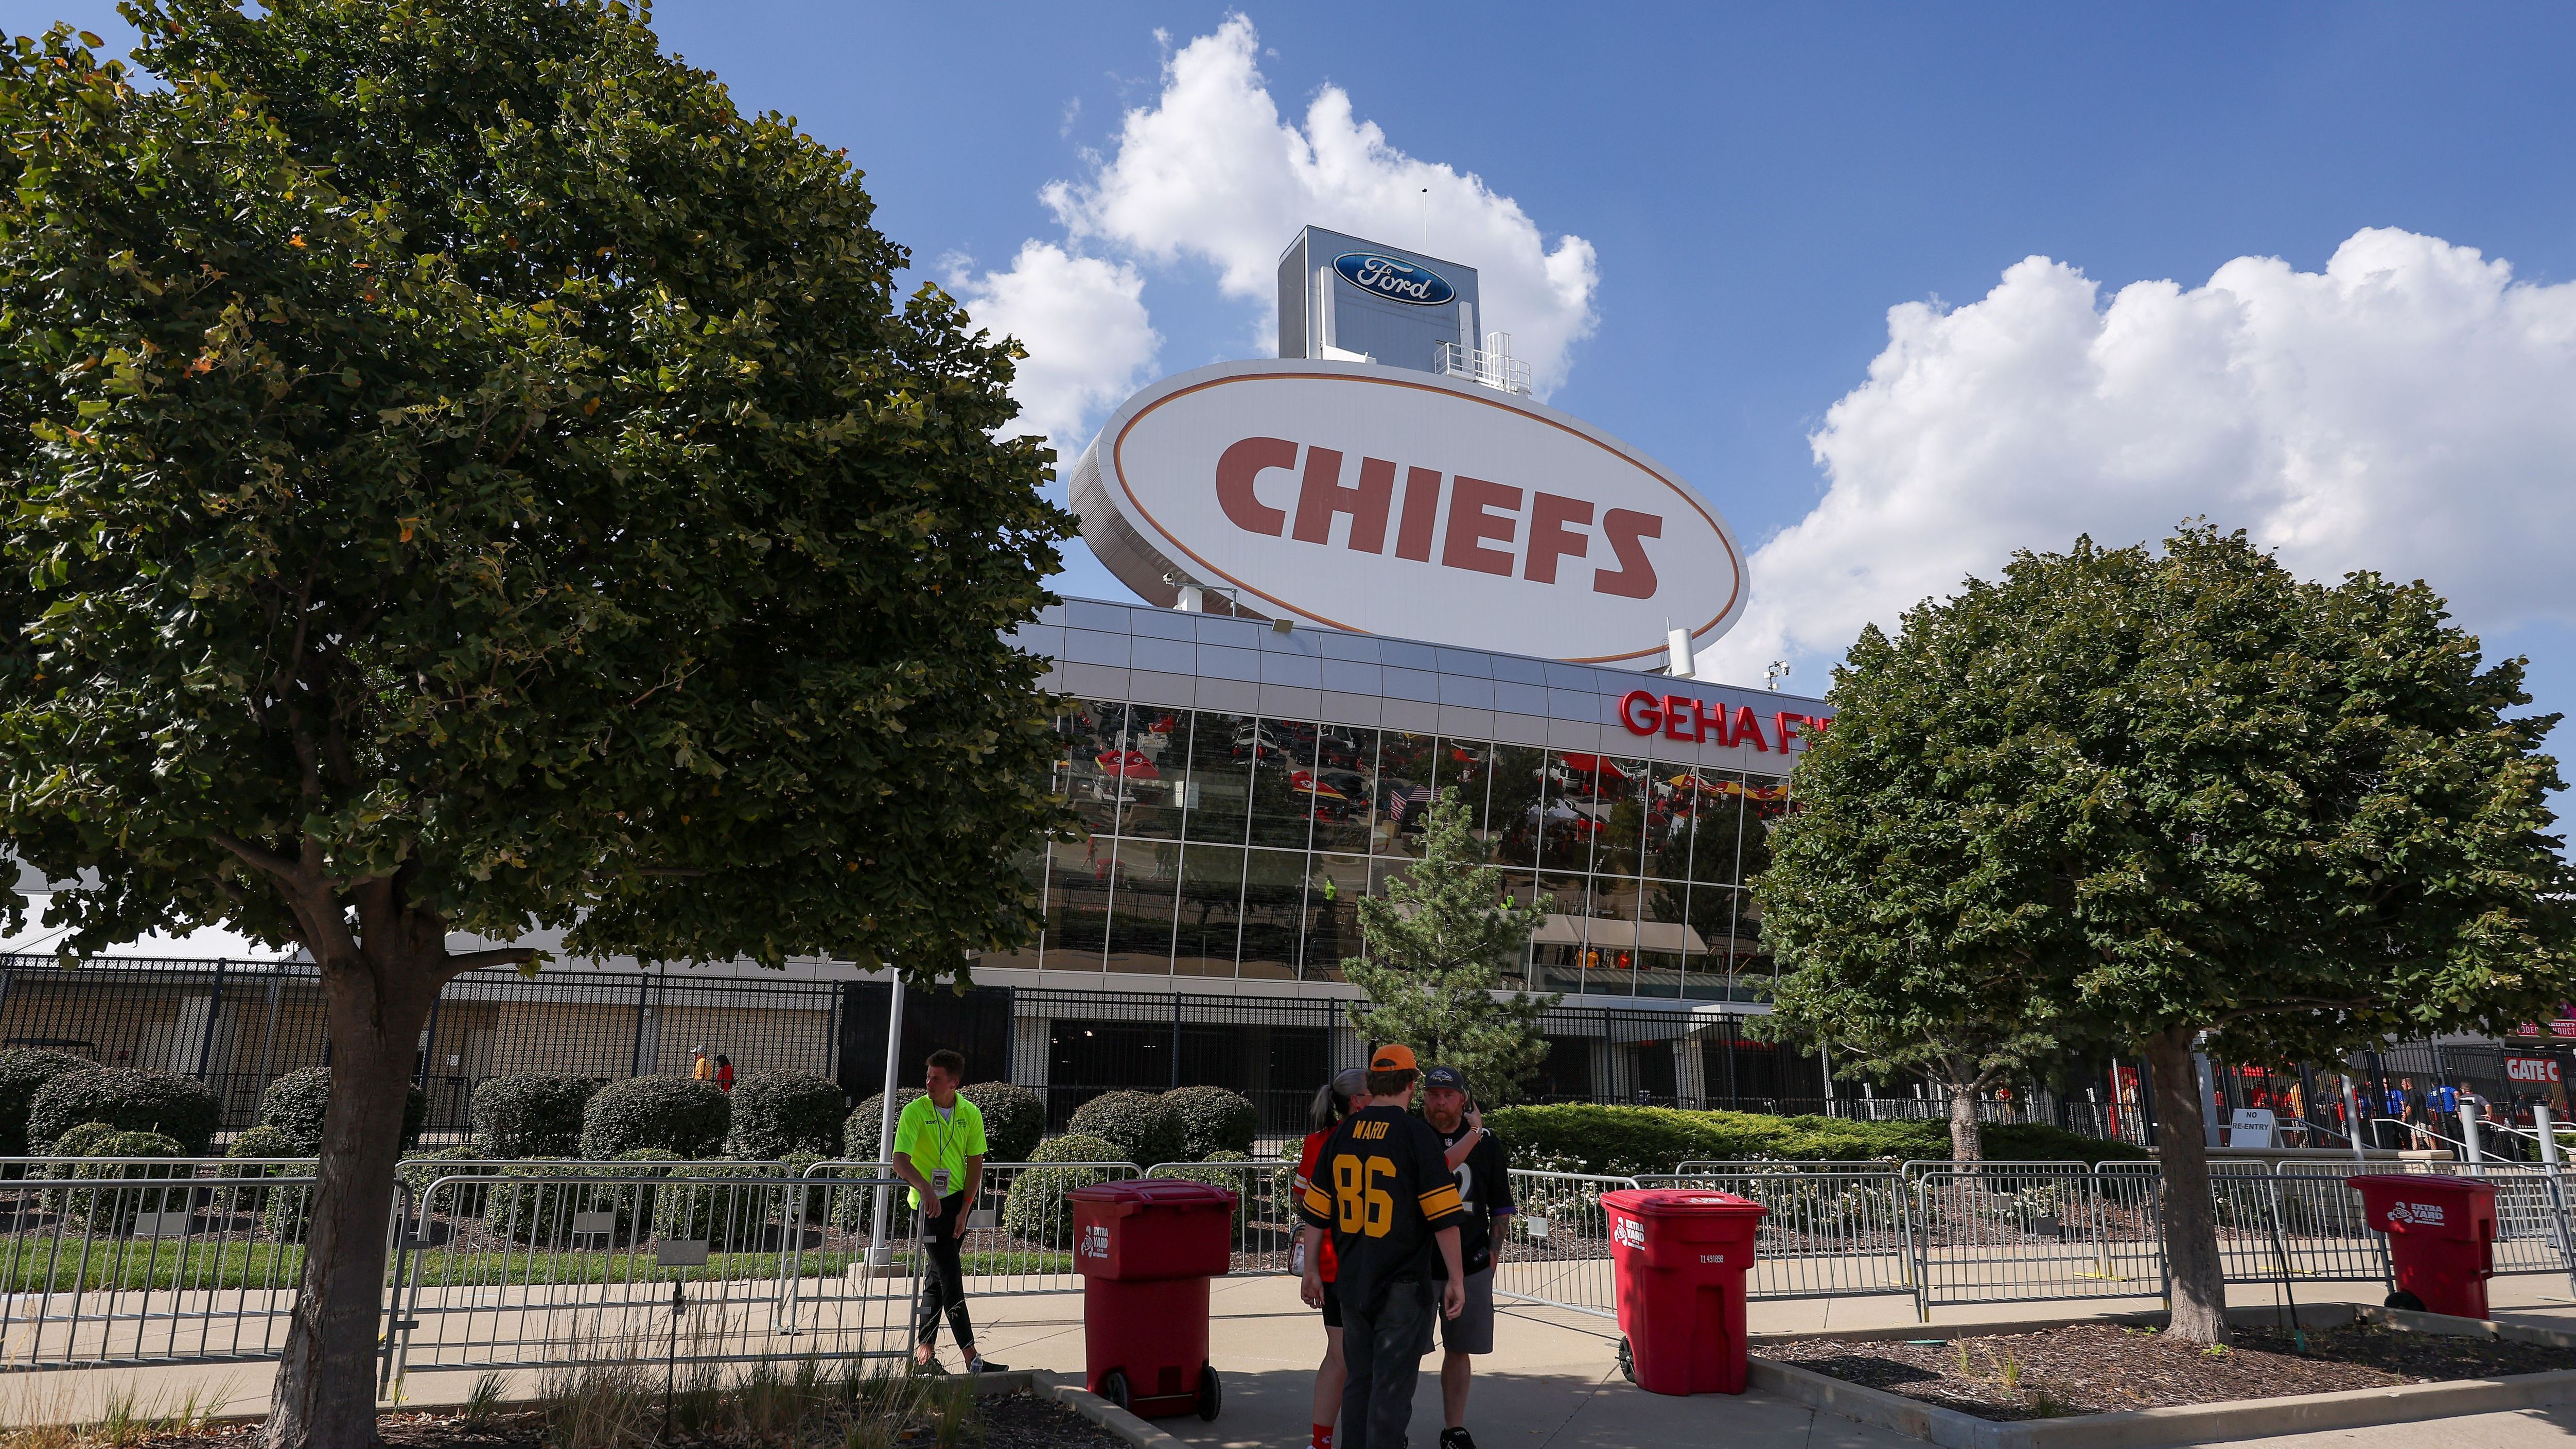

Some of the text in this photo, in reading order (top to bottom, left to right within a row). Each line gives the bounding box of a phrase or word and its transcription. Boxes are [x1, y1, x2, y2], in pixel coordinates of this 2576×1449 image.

[1357, 257, 1431, 299] Ford
[1216, 437, 1662, 599] CHIEFS
[1621, 690, 1769, 752] GEHA
[2507, 1059, 2558, 1081] GATE C
[1352, 1120, 1390, 1140] WARD
[1333, 1154, 1396, 1238] 86
[2411, 1203, 2443, 1213] EXTRA
[2412, 1210, 2444, 1219] YARD
[1093, 1226, 1109, 1237] EXTRA
[1626, 1218, 1644, 1233] EXTRA
[1093, 1236, 1108, 1249] YARD
[1626, 1228, 1645, 1243] YARD
